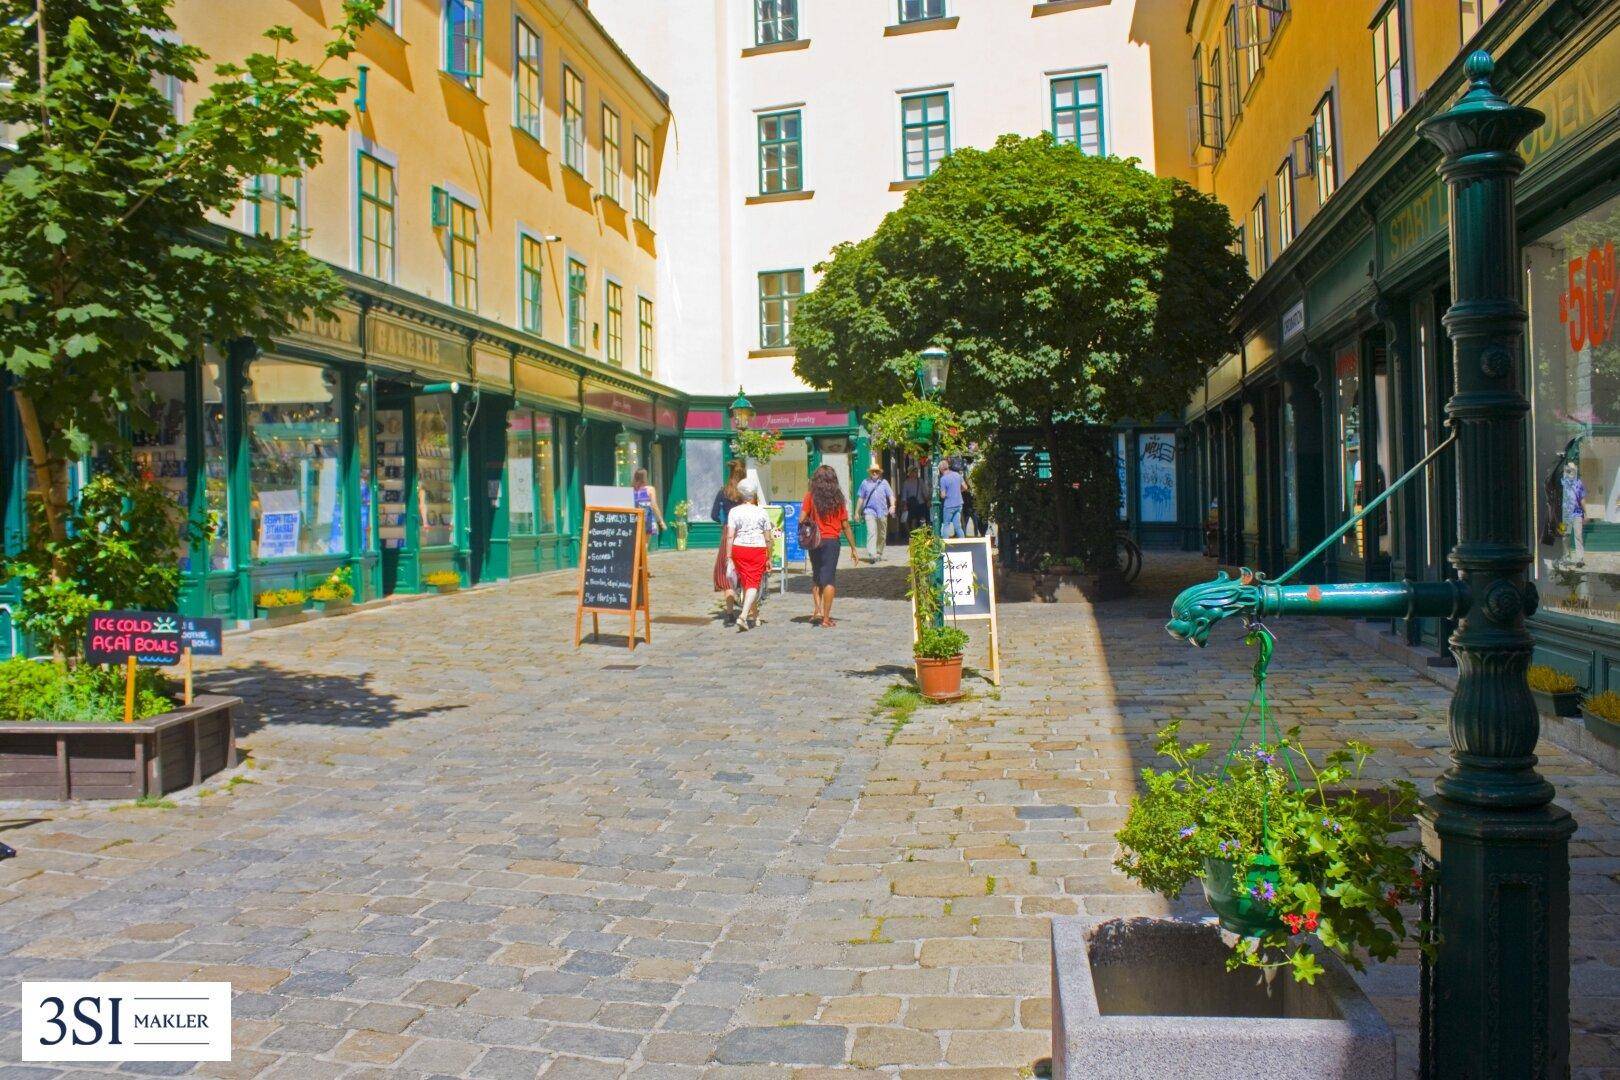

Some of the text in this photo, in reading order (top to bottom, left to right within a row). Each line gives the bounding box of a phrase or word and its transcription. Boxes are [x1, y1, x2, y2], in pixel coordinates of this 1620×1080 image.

[378, 322, 440, 364] GALERIE
[94, 618, 152, 633] ICE COLD
[134, 637, 179, 654] BOWLS
